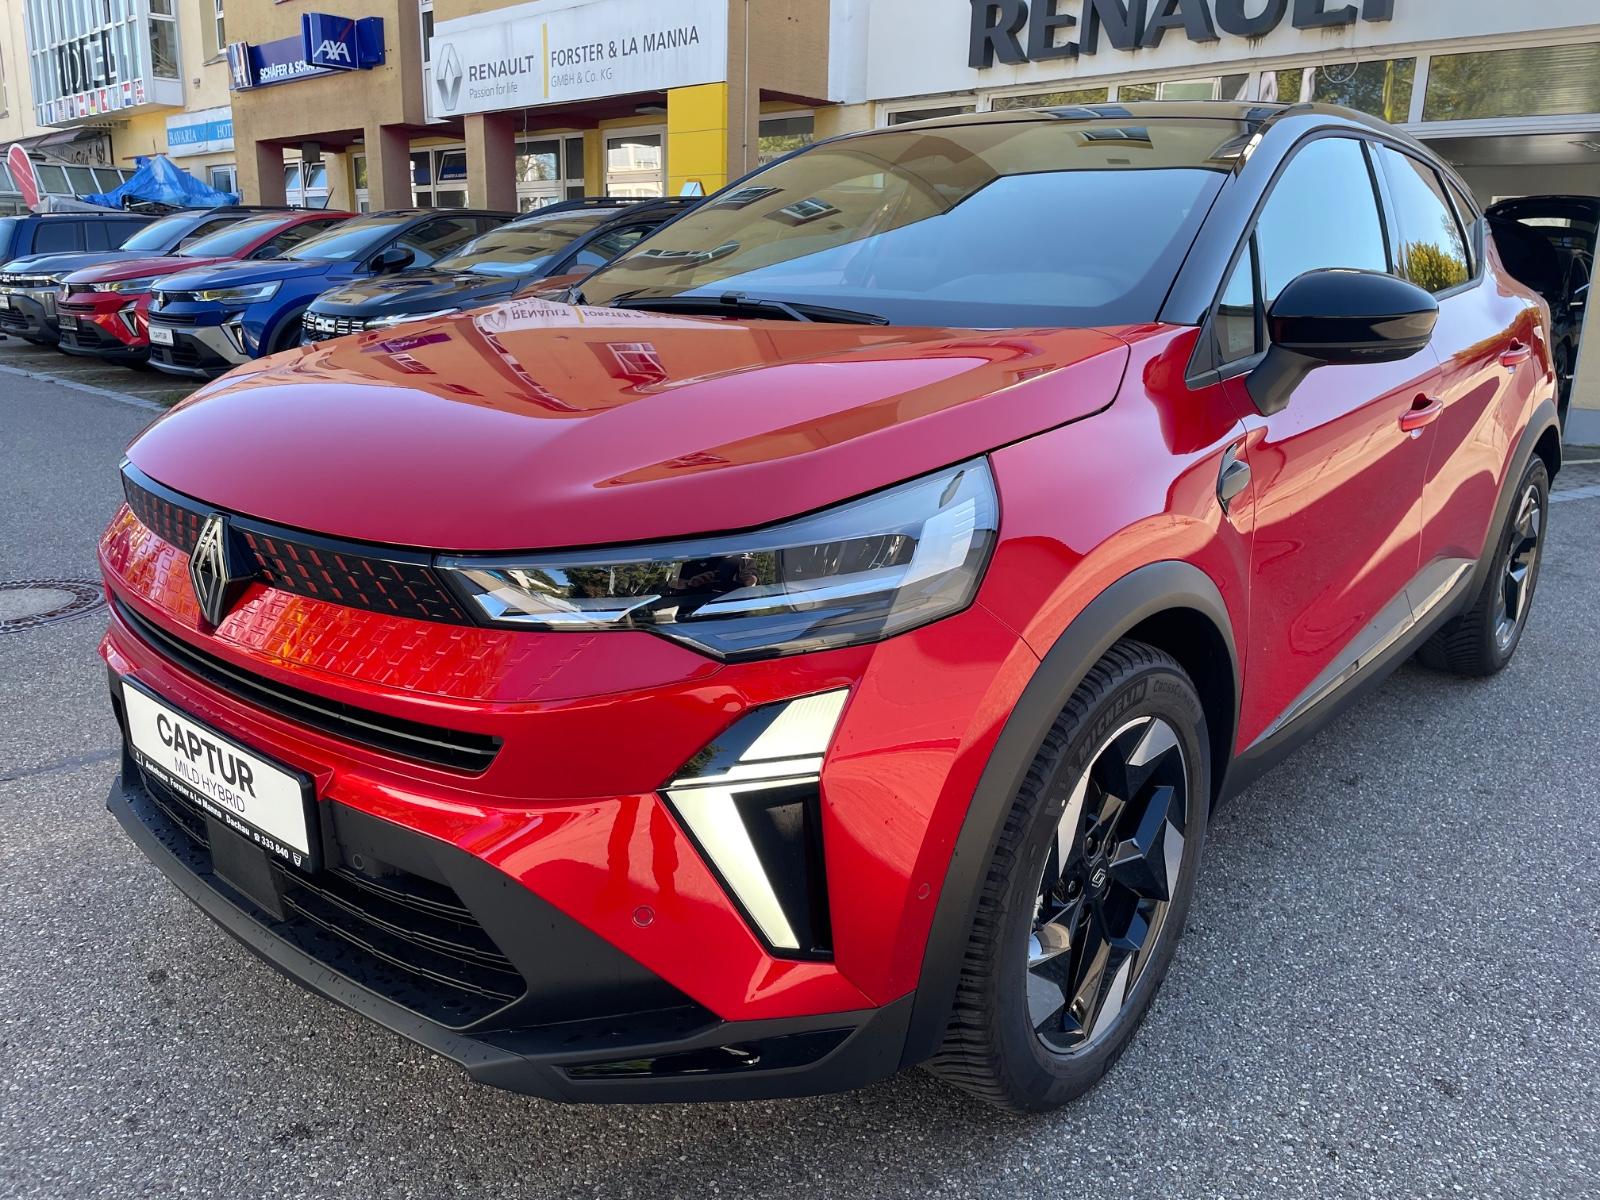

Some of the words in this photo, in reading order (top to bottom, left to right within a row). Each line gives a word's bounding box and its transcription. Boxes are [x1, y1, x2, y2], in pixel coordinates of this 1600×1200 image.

[313, 40, 351, 62] AXA
[551, 43, 604, 67] FORSTER
[608, 40, 617, 58] &
[622, 37, 638, 56] LA
[643, 25, 699, 53] MANNA
[260, 63, 288, 80] SCHÄFER
[288, 62, 295, 74] &
[469, 55, 534, 82] RENAULT
[577, 72, 583, 83] &
[601, 68, 613, 80] KG
[469, 86, 495, 99] Passion
[495, 85, 506, 96] for
[506, 82, 518, 94] life
[169, 129, 197, 145] BAVARIA
[1079, 682, 1146, 763] MICHELIN
[157, 713, 256, 798] CAPTUR
[175, 757, 199, 784] MILD
[202, 774, 245, 812] HYBRID
[226, 814, 249, 835] Dachau
[261, 836, 274, 850] 333
[275, 844, 288, 858] 840
